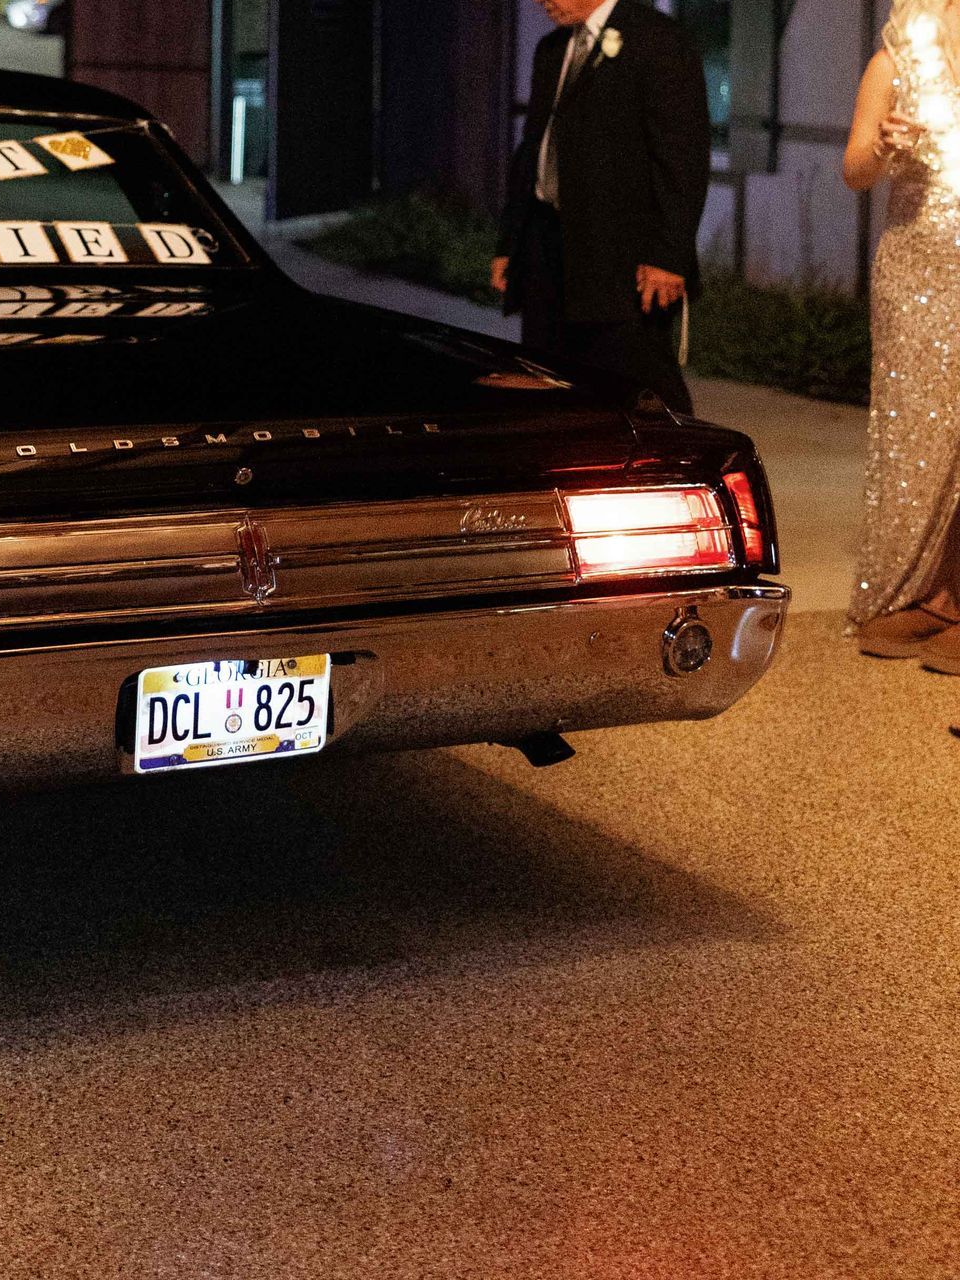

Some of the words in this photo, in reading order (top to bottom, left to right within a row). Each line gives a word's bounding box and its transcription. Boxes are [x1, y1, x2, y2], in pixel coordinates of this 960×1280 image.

[16, 424, 442, 458] OLDSMOBILE
[148, 692, 211, 745] DCL
[254, 679, 315, 732] 825
[295, 731, 312, 741] OCT
[228, 743, 258, 755] ARMY
